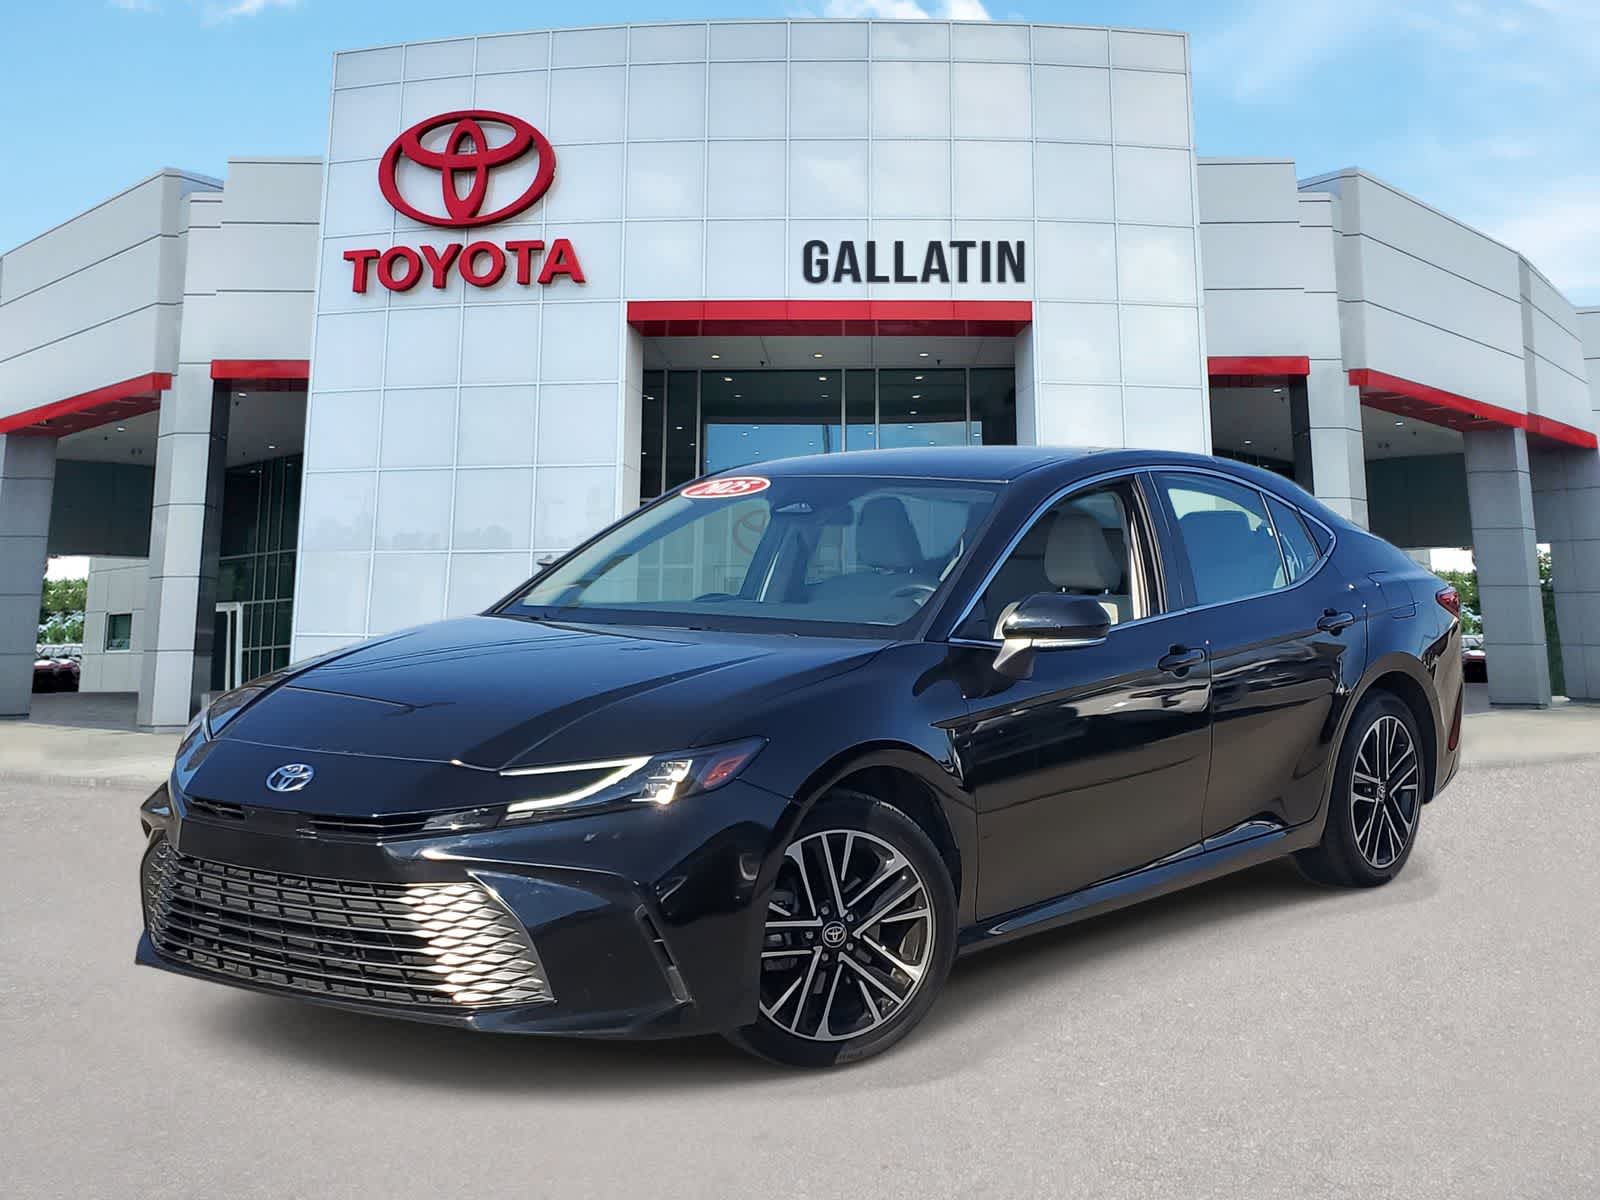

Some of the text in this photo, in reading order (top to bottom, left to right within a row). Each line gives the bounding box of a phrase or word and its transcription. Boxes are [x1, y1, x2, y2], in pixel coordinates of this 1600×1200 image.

[343, 238, 586, 293] TOYOTA
[803, 240, 1026, 284] GALLATIN
[690, 480, 762, 495] 2025
